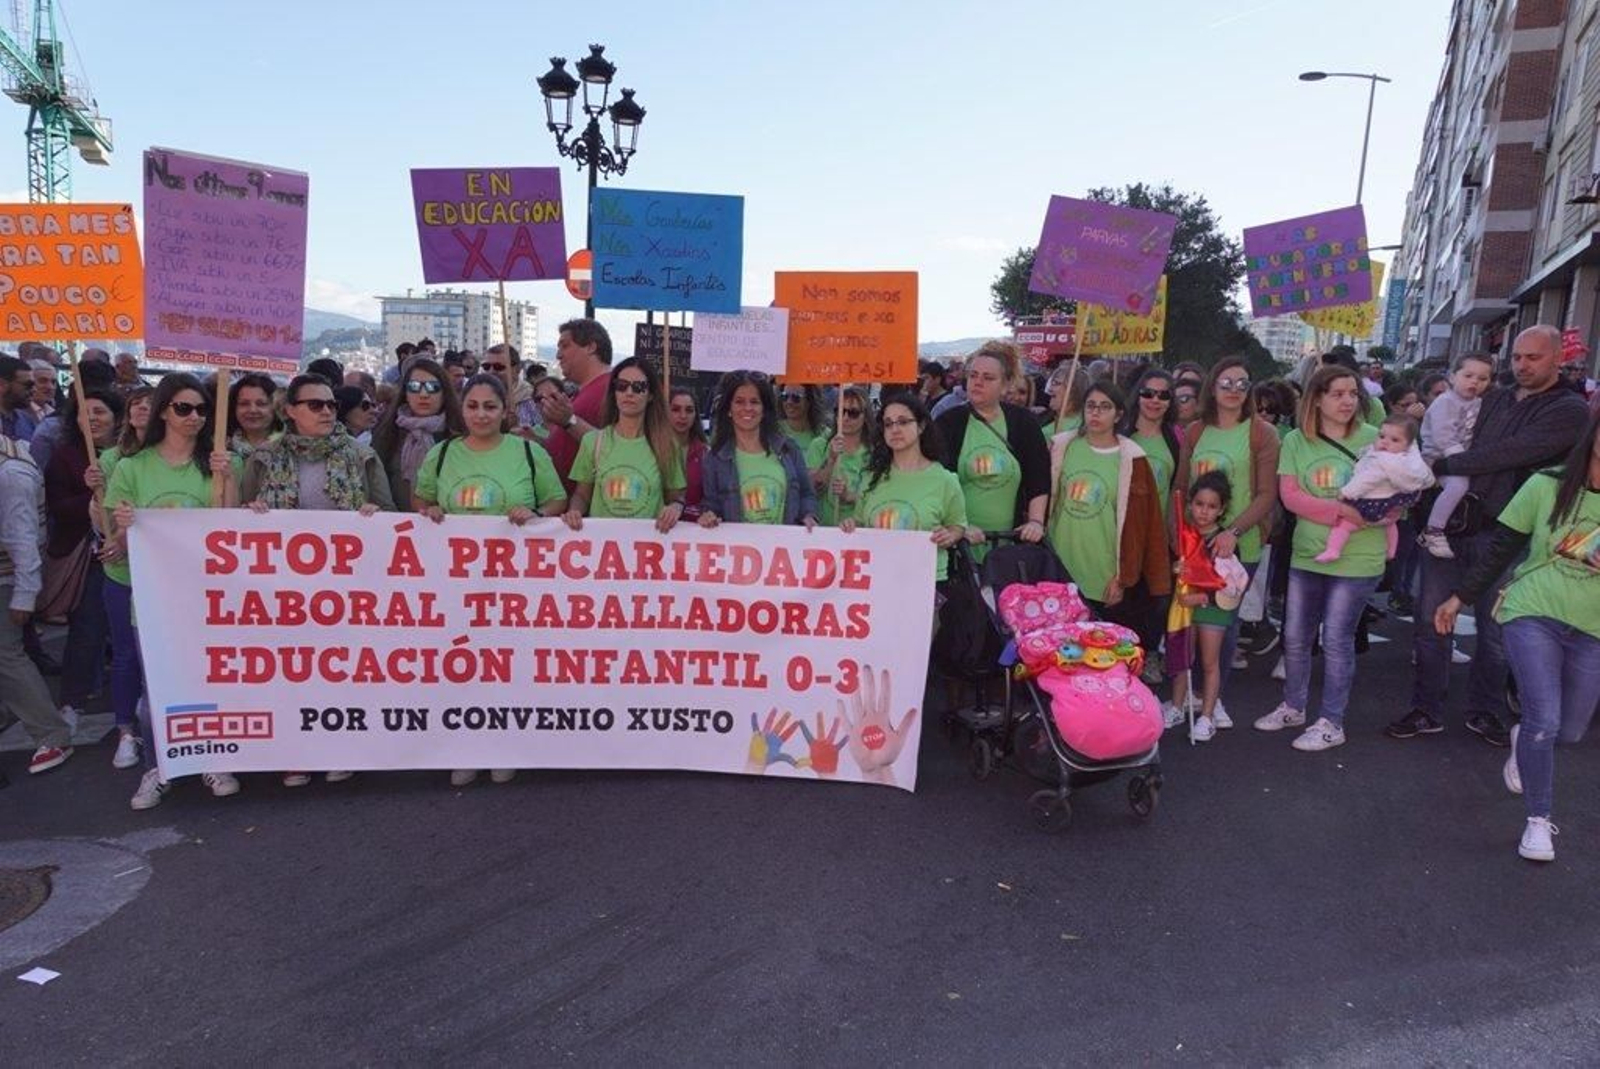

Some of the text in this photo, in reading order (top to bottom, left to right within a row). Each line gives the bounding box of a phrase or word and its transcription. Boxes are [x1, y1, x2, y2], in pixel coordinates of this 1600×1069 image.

[466, 172, 512, 197] EN
[55, 243, 122, 267] TAN
[451, 226, 545, 281] XA
[847, 288, 903, 303] somos
[205, 520, 871, 591] STOP Á PRECARIEDADE
[205, 589, 872, 640] LABORAL TRABALLADORAS
[205, 634, 860, 695] EDUCACIÓN INFANTIL 0-3
[168, 714, 271, 740] CCOO
[299, 706, 734, 734] POR UN CONVENIO XUSTO
[166, 740, 239, 759] ensino
